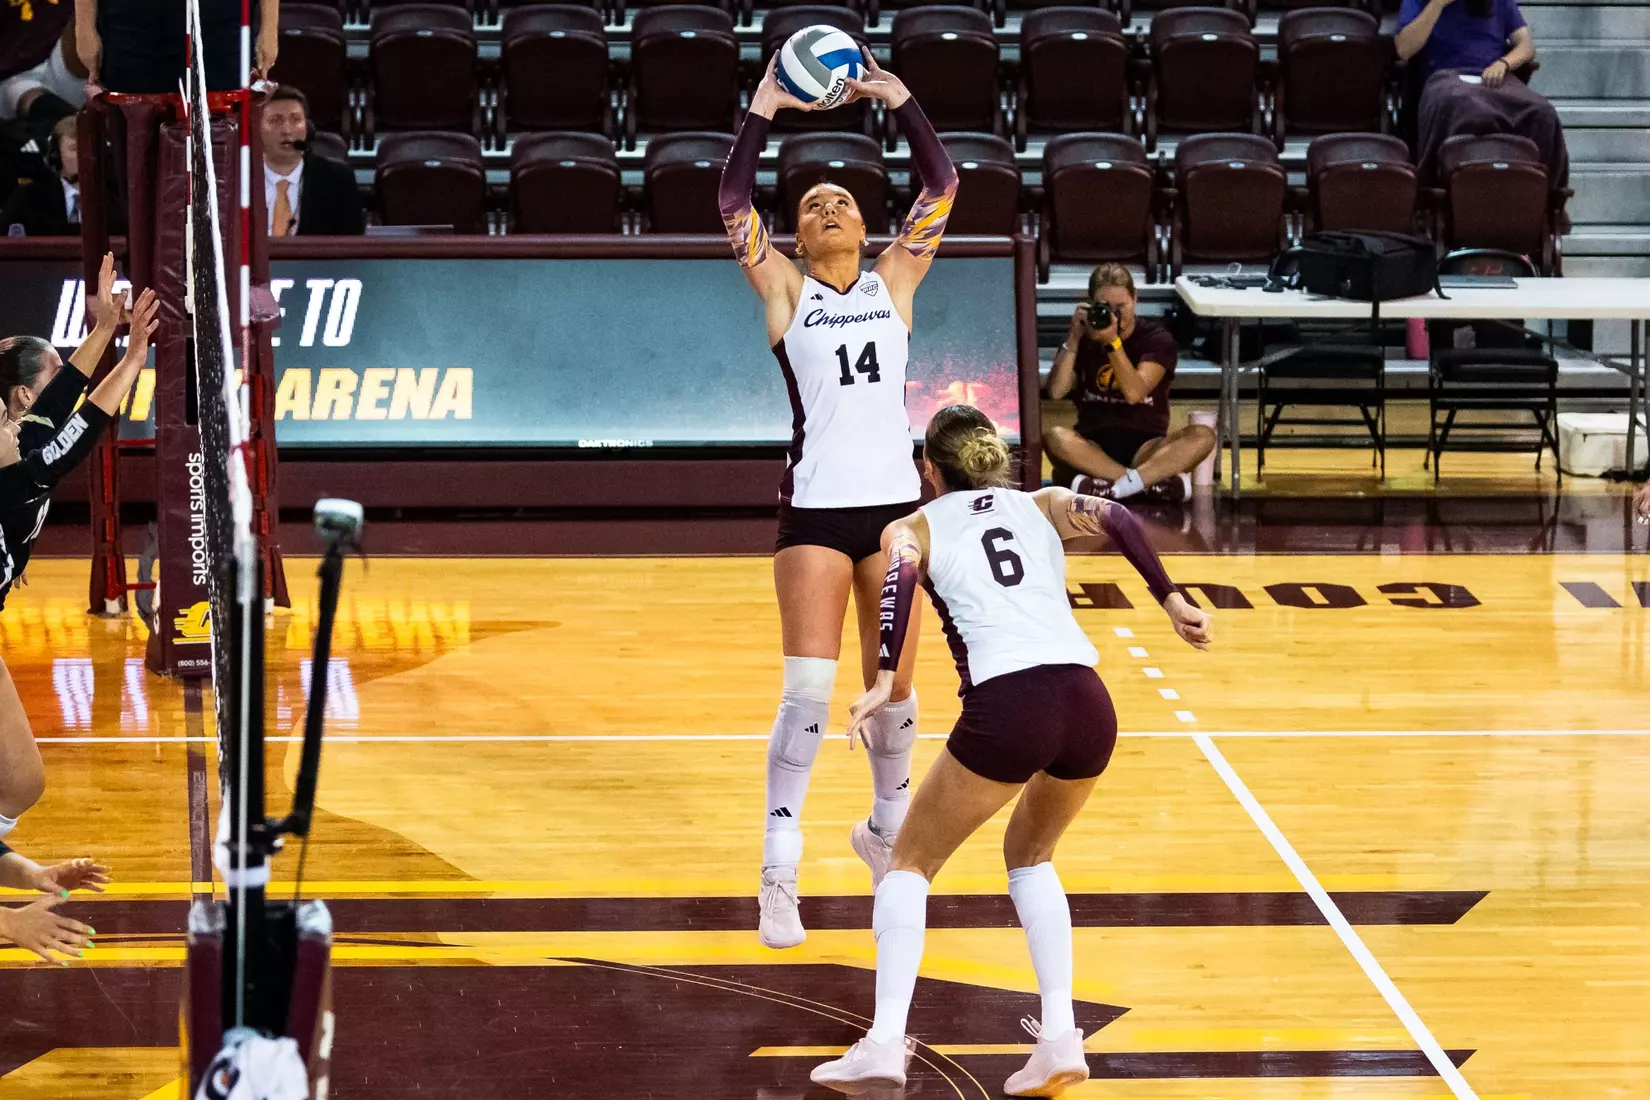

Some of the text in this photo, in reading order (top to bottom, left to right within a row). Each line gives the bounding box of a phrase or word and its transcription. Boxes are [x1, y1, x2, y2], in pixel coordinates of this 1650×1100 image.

[299, 277, 363, 347] TO
[803, 308, 891, 328] Chippewas
[835, 341, 881, 386] 14
[274, 367, 473, 421] ARENA
[42, 412, 90, 466] GOLDEN
[185, 452, 209, 585] sports imports
[981, 527, 1025, 587] 6
[880, 556, 900, 631] IPPEWAS
[1066, 582, 1482, 608] COUR
[177, 659, 213, 667] (800) 556-
